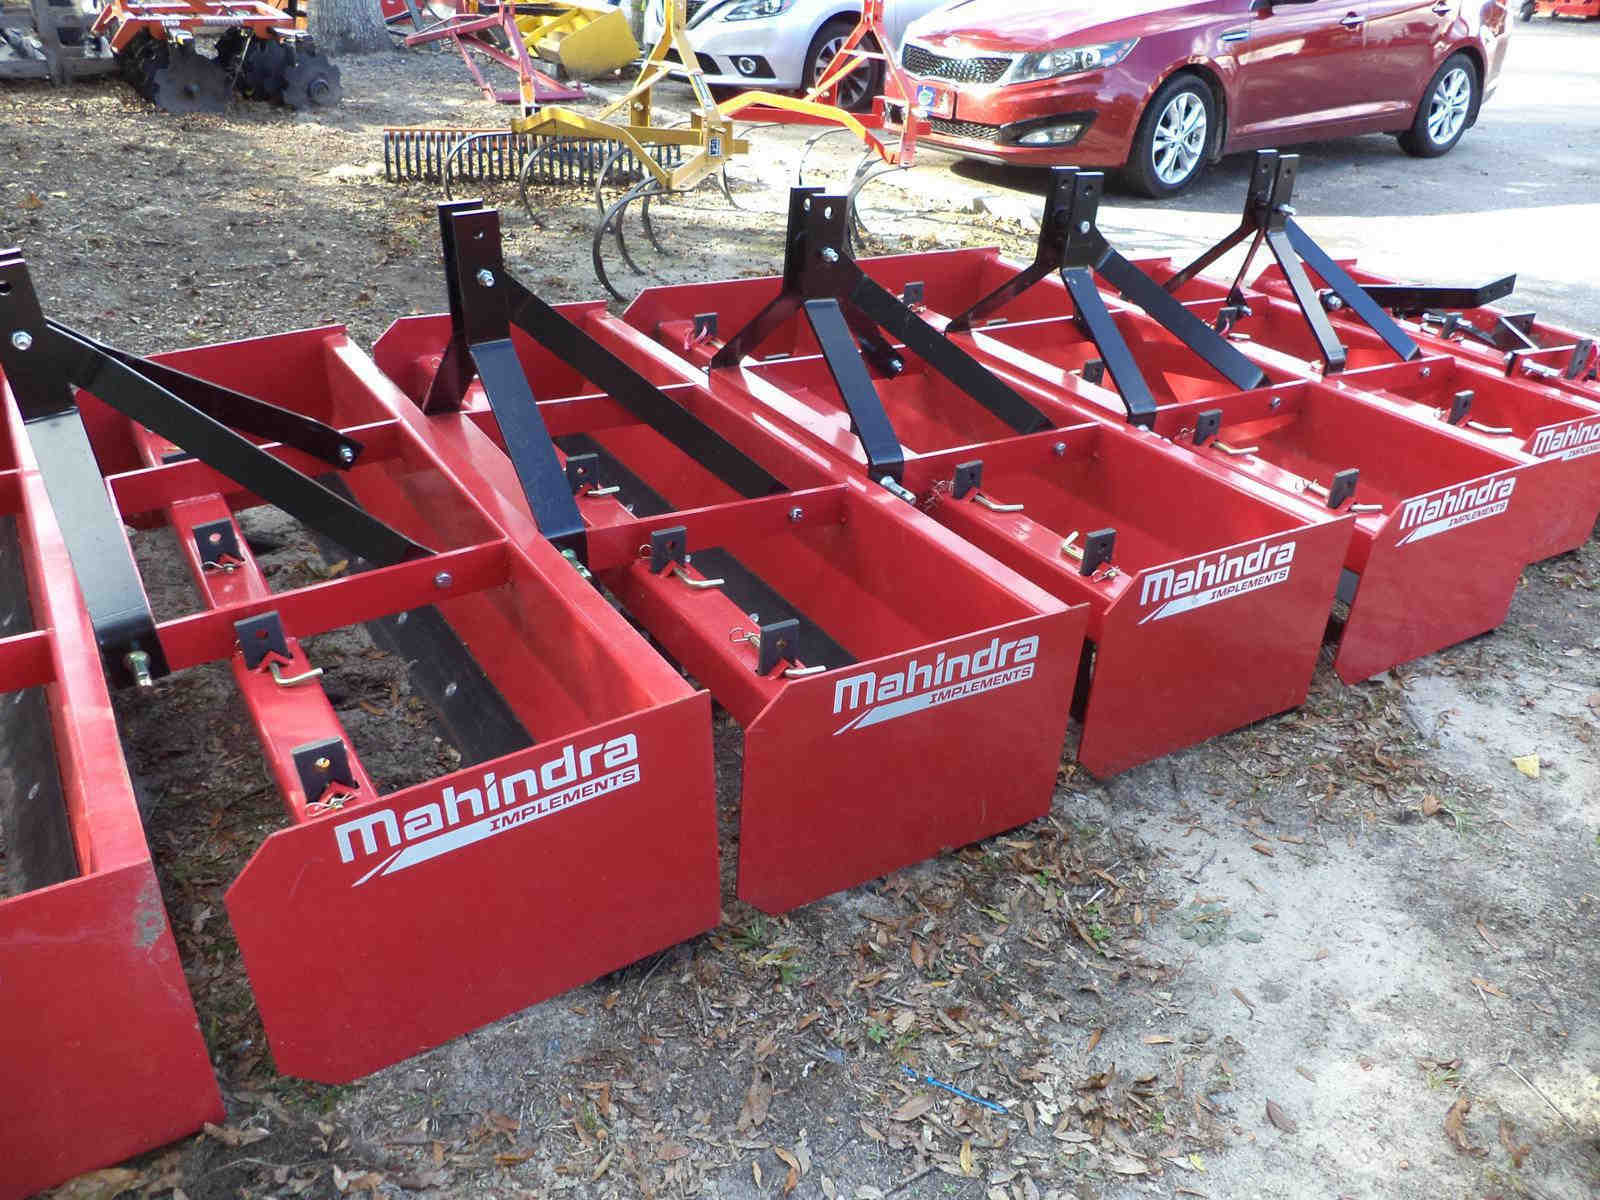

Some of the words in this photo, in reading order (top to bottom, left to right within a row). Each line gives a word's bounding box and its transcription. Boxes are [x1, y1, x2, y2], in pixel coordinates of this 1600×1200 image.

[1400, 477, 1516, 530] Mahindra
[1448, 501, 1506, 526] IMPLEMENTS
[1140, 541, 1296, 606] Mahindra
[1210, 569, 1287, 600] IMPLEMENTS
[833, 635, 1039, 714] Mahindra
[928, 667, 1031, 704] IMPLEMENTS
[335, 733, 638, 863] Mahindra
[489, 769, 636, 832] IMPLEMENTS
